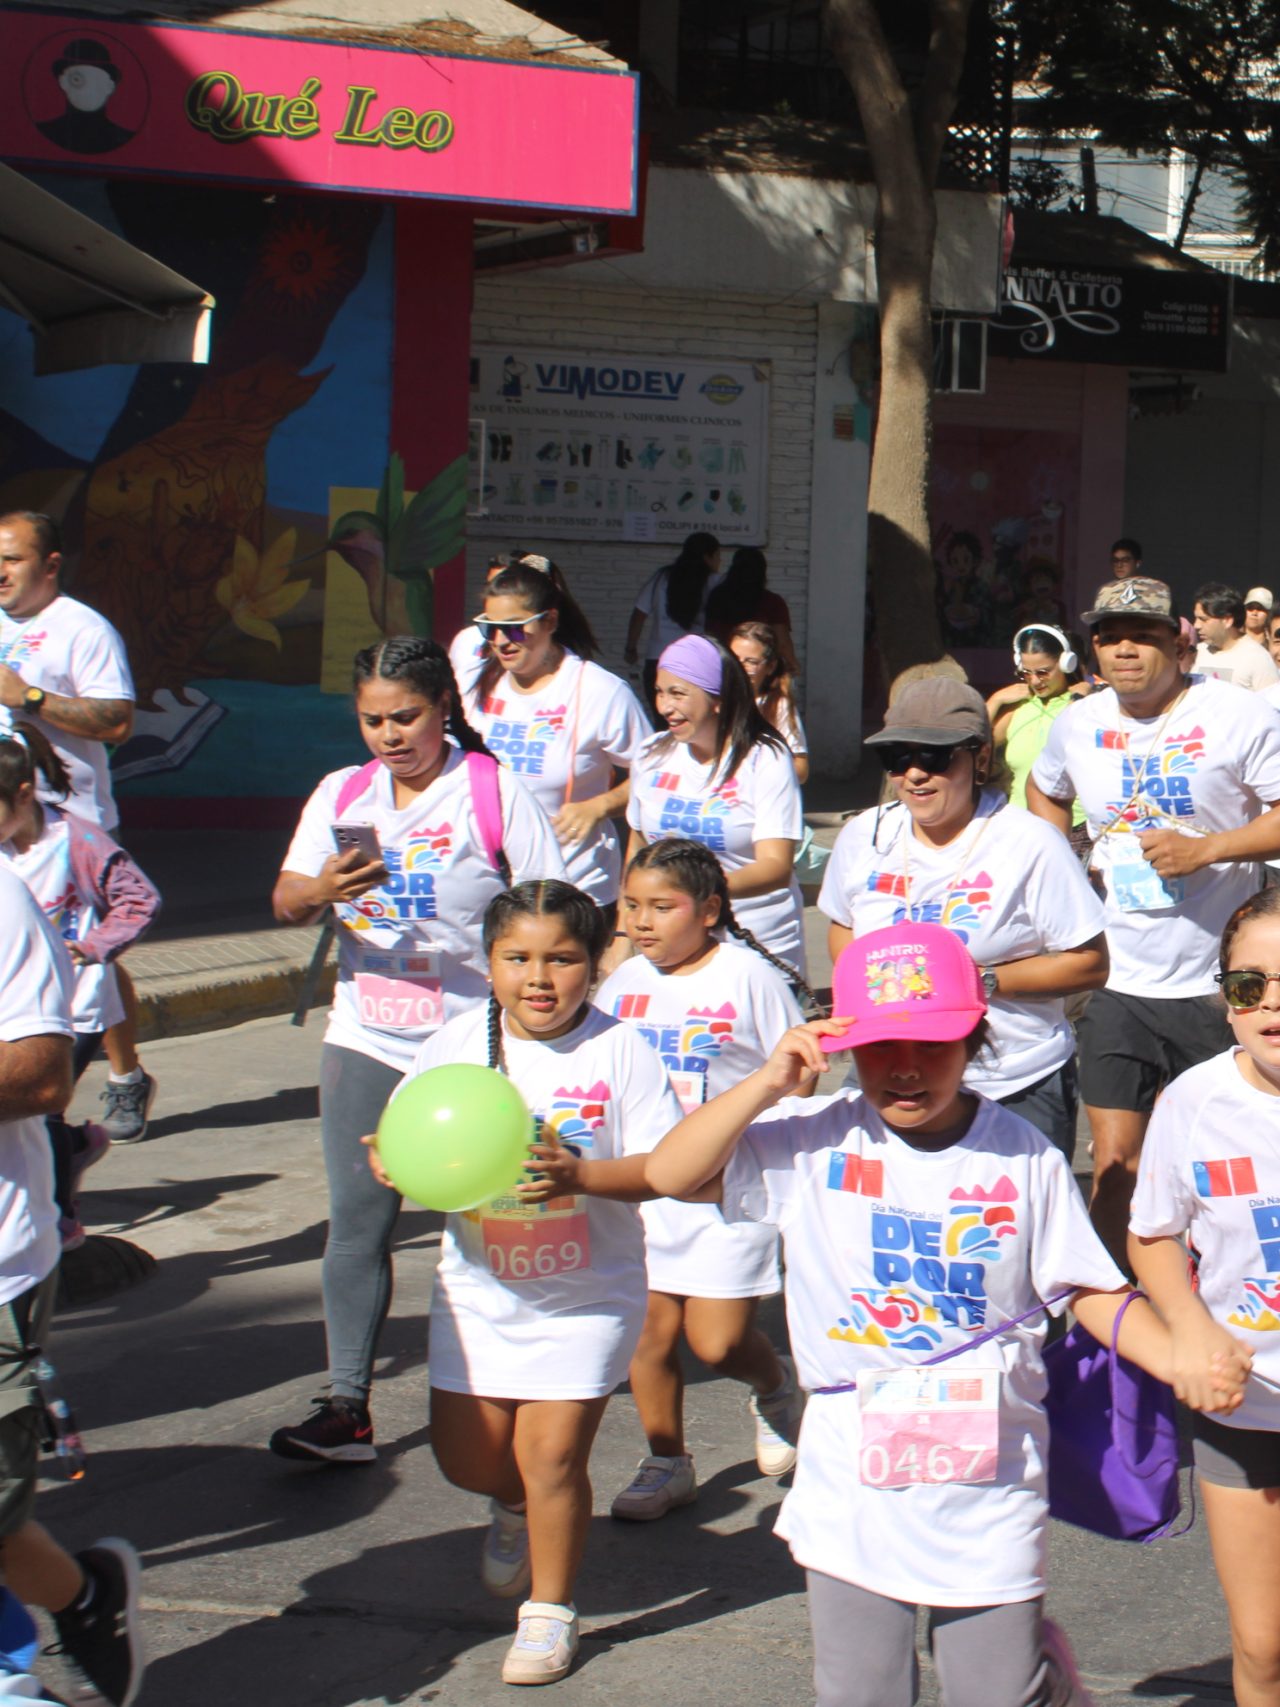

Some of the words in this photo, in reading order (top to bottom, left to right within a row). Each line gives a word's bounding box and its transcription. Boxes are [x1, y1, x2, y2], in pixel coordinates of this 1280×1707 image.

[184, 70, 322, 143] Qué
[333, 85, 454, 153] Leo
[1059, 271, 1068, 281] &
[1001, 275, 1122, 308] NNATTO
[535, 363, 687, 400] VIMODEV
[507, 406, 561, 416] INSUMOS
[564, 409, 615, 418] MEDICOS
[624, 411, 688, 424] UNIFORMES
[690, 416, 742, 426] CLINICOS
[490, 722, 528, 740] DE
[486, 738, 546, 757] POR
[511, 756, 544, 774] TE
[1122, 756, 1161, 777] DE
[663, 797, 703, 816] DE
[1157, 797, 1195, 816] TE
[659, 814, 724, 835] POR
[393, 897, 438, 918] TE
[361, 995, 436, 1025] 0670
[888, 1206, 926, 1219] Nacional
[872, 1213, 943, 1257] DE
[487, 1241, 582, 1278] 0669
[873, 1251, 988, 1298] POR
[932, 1294, 988, 1325] TE
[861, 1443, 987, 1484] 0467
